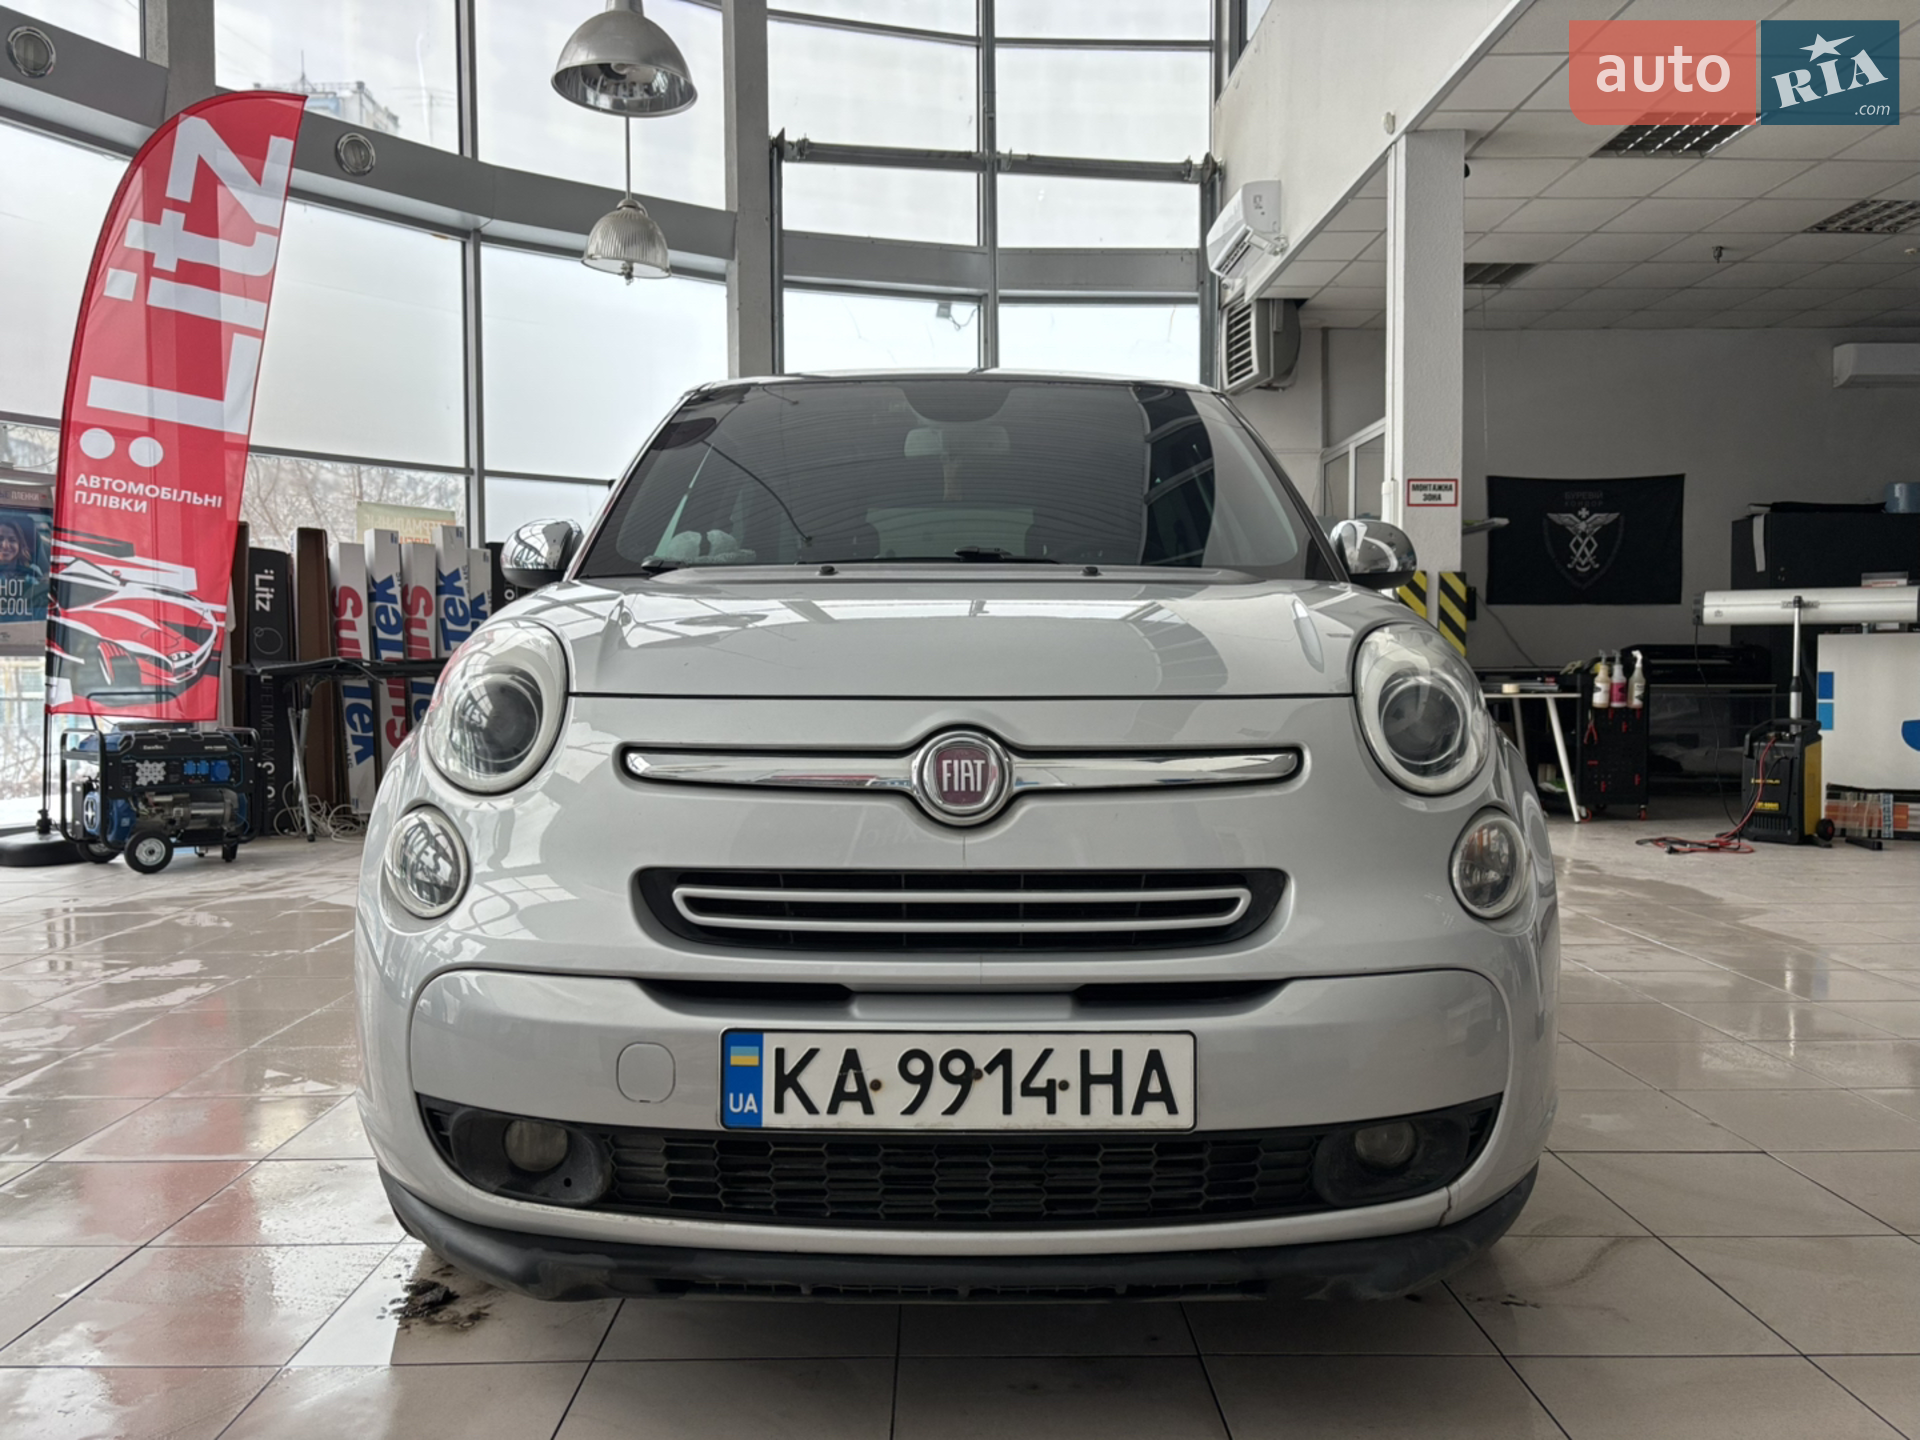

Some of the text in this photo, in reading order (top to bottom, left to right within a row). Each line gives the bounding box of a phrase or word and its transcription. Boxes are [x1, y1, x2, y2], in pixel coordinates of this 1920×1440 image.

[86, 112, 294, 435] Litz
[74, 490, 148, 514] ПЛІВКИ
[75, 473, 223, 508] АВТОМОБІЛЬНІ
[0, 578, 25, 597] HOT
[254, 570, 275, 612] Litz
[0, 597, 33, 616] COOL
[942, 759, 986, 792] FIAT
[729, 1047, 1179, 1116] UA KA 9914 HA
